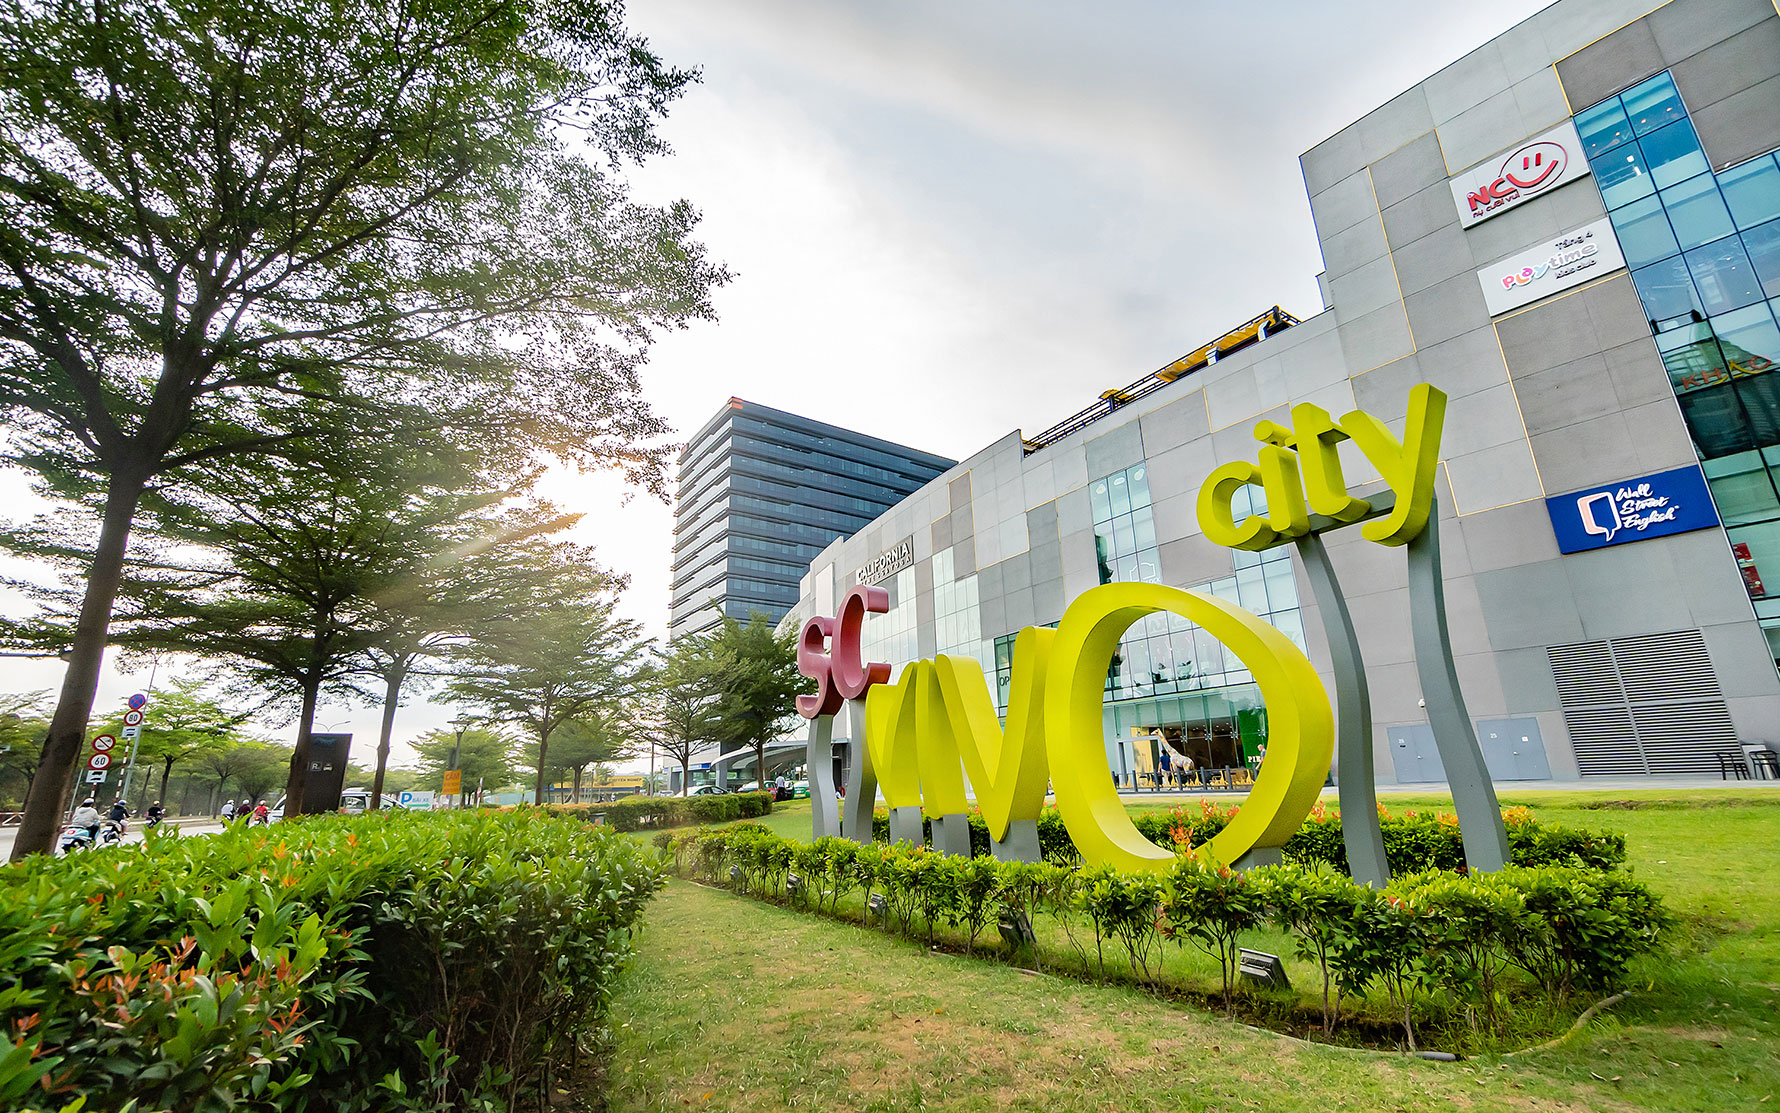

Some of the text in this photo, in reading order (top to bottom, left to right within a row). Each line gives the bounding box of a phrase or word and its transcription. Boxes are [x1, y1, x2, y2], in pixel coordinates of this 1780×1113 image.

[1197, 382, 1448, 552] city
[1616, 483, 1653, 502] Wall
[1620, 497, 1669, 515] Street
[1621, 506, 1676, 531] English
[858, 542, 910, 581] CALIFORNIA
[795, 584, 892, 719] SC
[865, 582, 1335, 873] VIVO
[94, 757, 106, 766] 60
